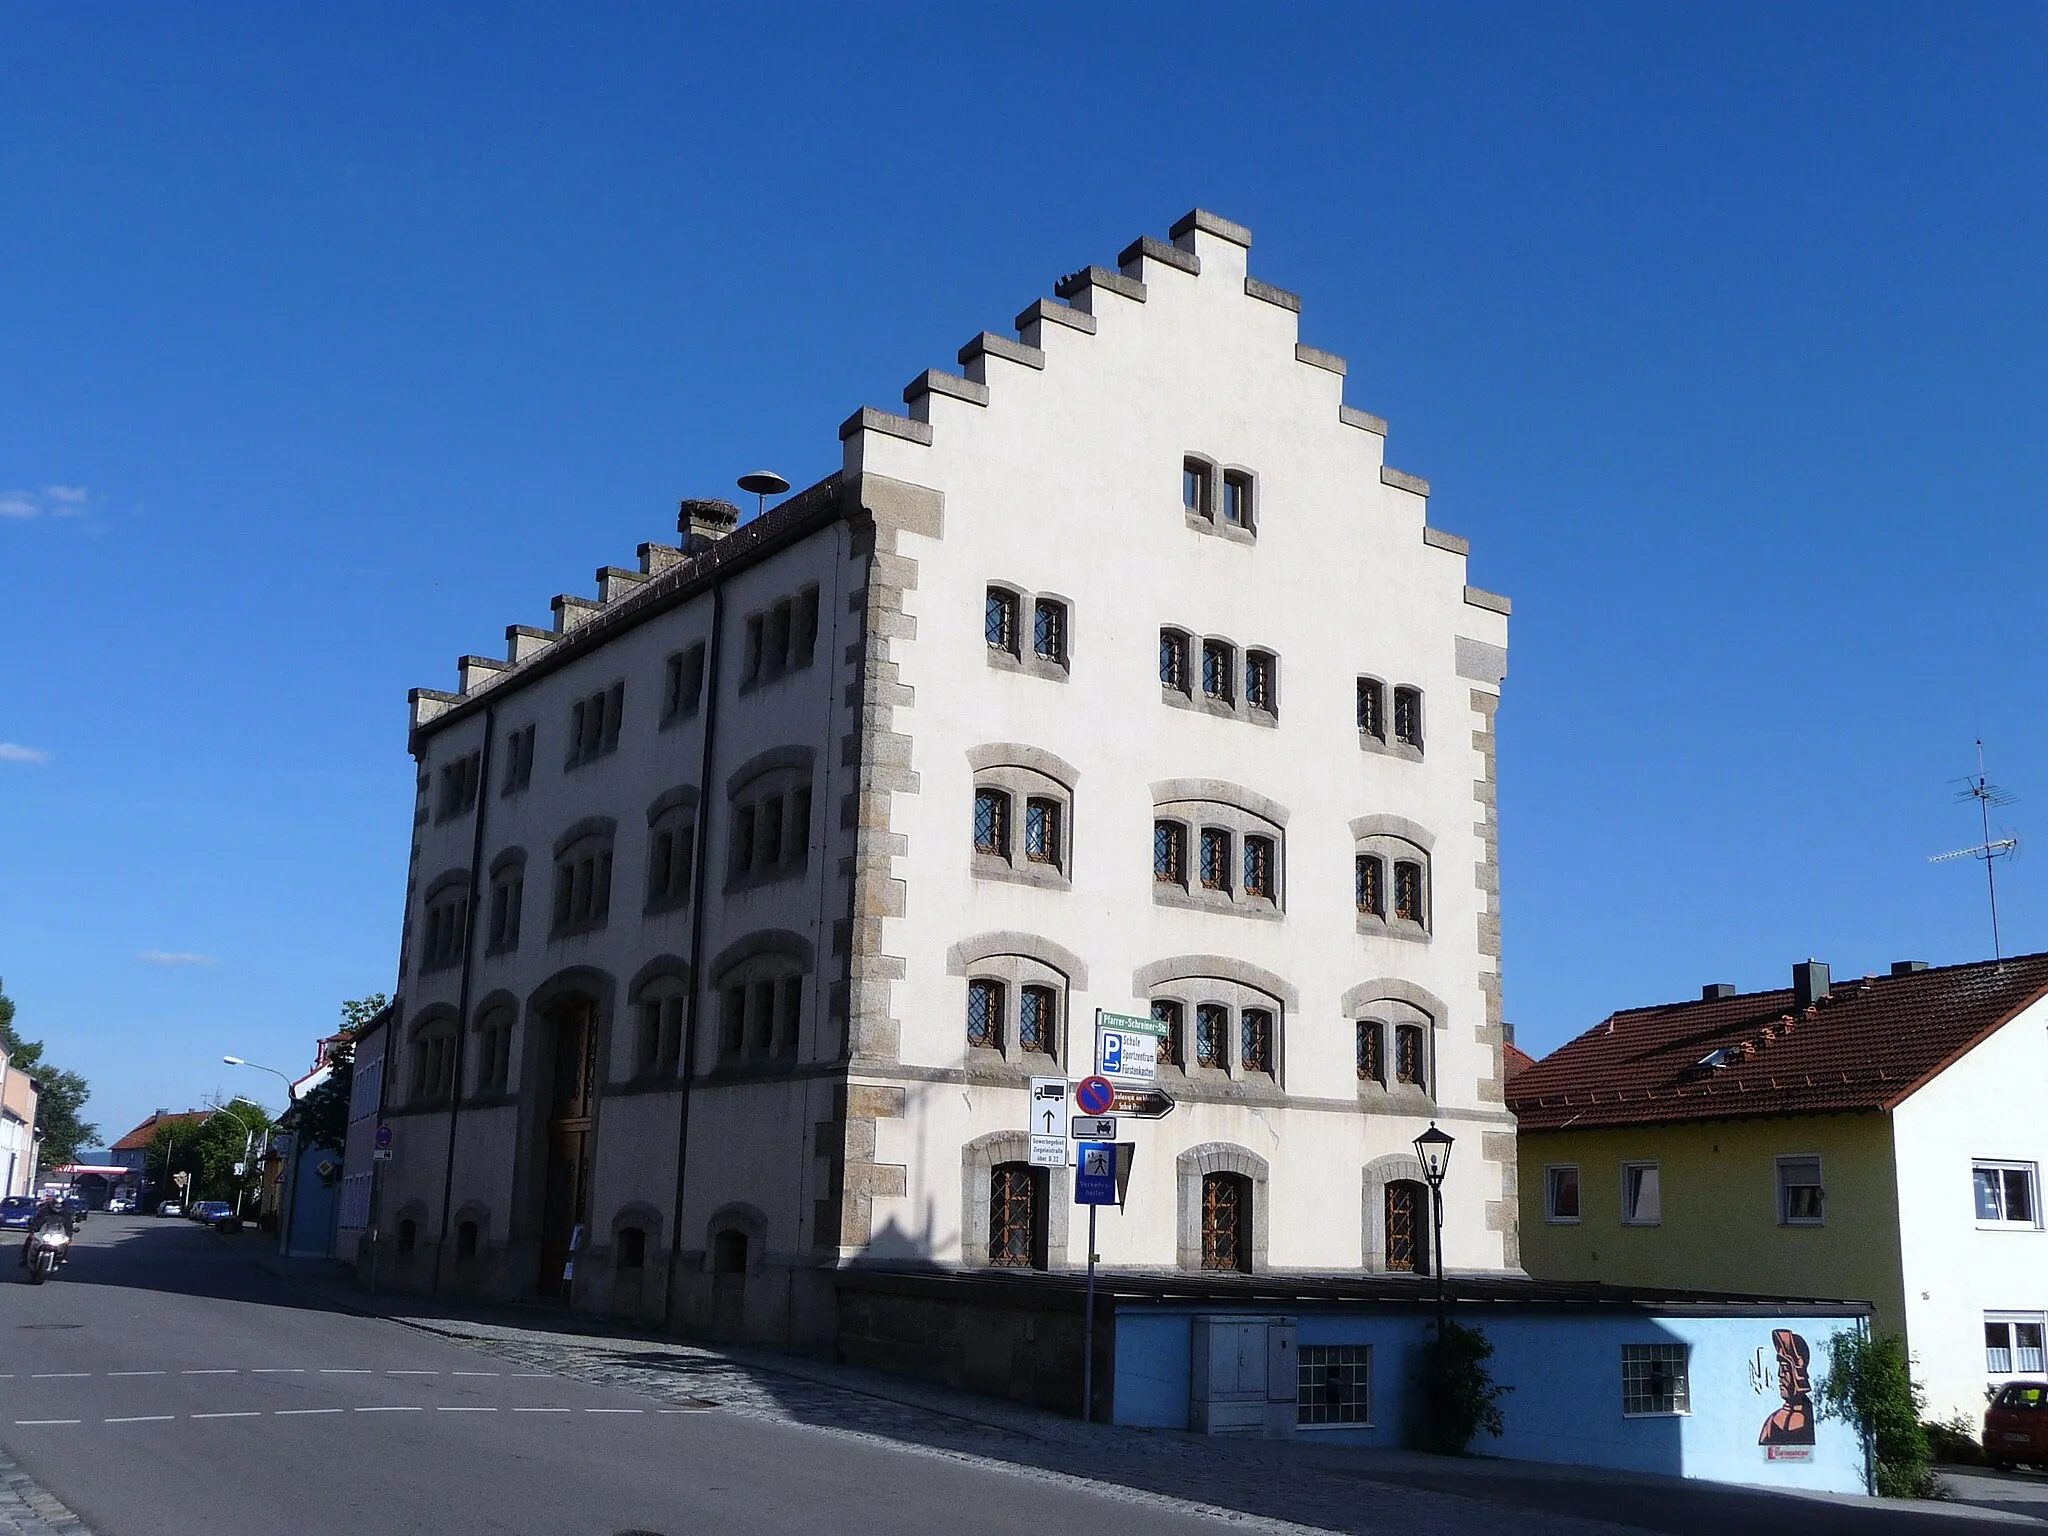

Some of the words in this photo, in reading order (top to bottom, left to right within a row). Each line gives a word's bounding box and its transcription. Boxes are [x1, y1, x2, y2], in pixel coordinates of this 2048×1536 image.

[1105, 1035, 1120, 1060] P
[1123, 1034, 1141, 1047] Schule
[1122, 1049, 1154, 1063] Sportzentrum
